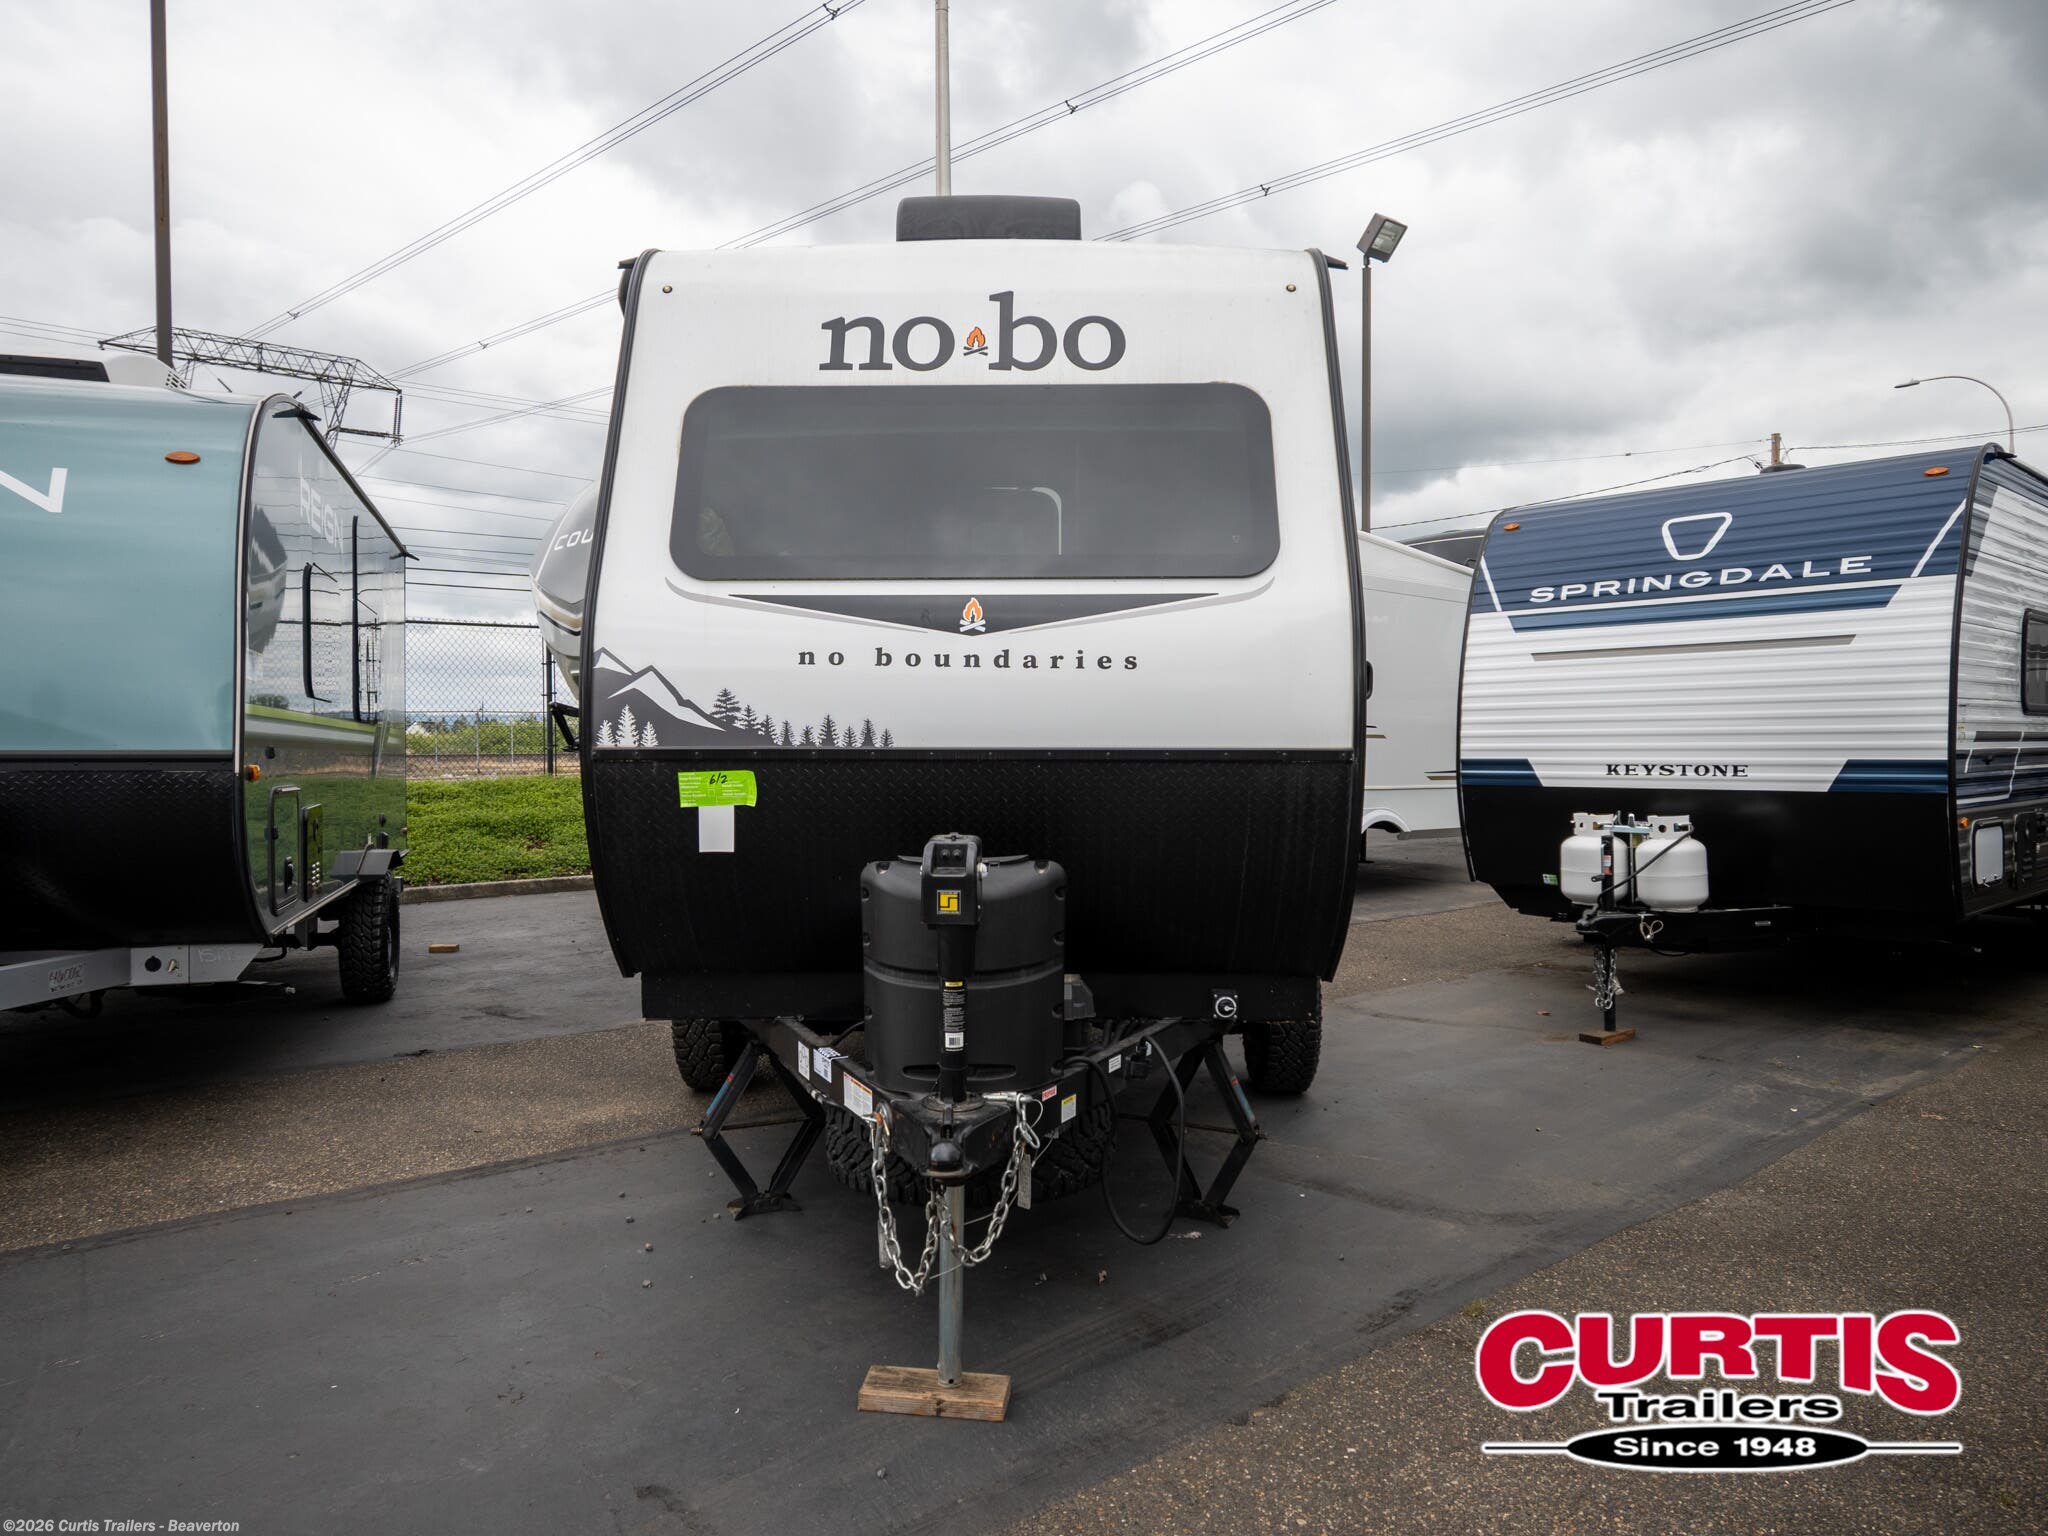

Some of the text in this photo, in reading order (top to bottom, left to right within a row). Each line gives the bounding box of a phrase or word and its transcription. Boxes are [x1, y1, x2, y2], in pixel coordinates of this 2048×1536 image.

[300, 477, 344, 558] REIGN
[1529, 555, 1873, 603] SPRINGDALE
[798, 647, 1138, 670] no boundaries
[1605, 763, 1749, 777] KEYSTONE
